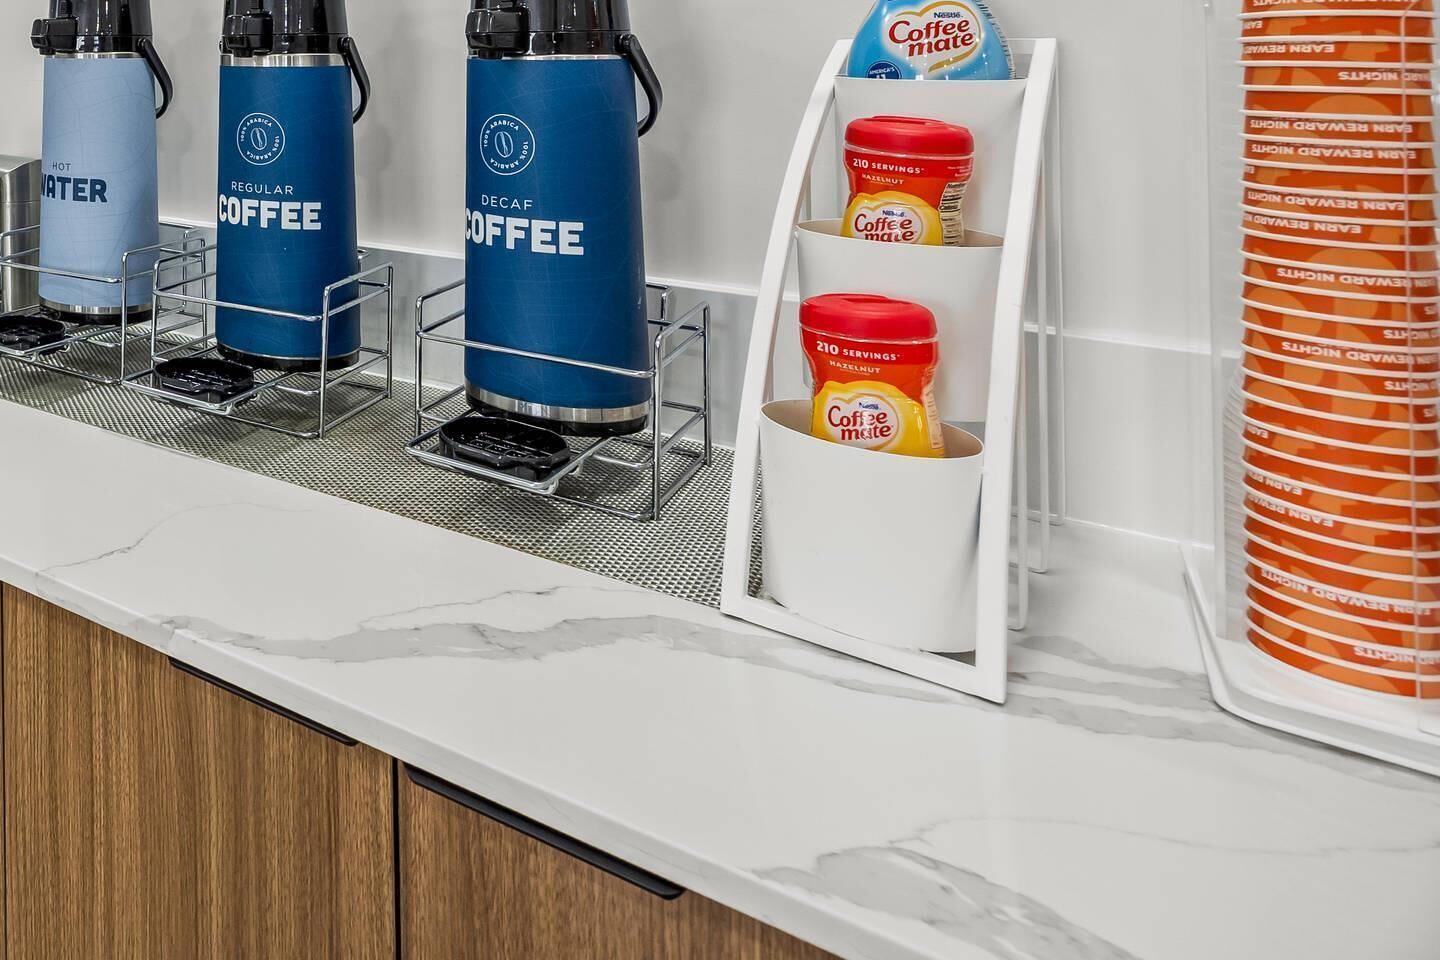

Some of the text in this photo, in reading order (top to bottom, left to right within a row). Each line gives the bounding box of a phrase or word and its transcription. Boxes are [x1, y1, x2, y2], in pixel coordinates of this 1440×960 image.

[888, 19, 970, 44] Coffee
[908, 32, 974, 57] mate
[1245, 43, 1335, 54] EARN REWAR
[1338, 71, 1398, 81] NIGHTS
[246, 117, 272, 128] ARABICA
[1250, 119, 1413, 134] EARN REWARD NIGHTS
[483, 119, 520, 147] 100% ARABICA
[246, 151, 272, 160] ARABICA
[490, 141, 529, 169] 100% ARABICA
[1251, 143, 1417, 160] EARN REWARD NIGHTS
[52, 161, 72, 172] HOT
[853, 158, 869, 169] 210
[862, 173, 905, 185] HAZELNUT
[231, 180, 294, 196] REGULAR
[481, 194, 533, 211] DECAF
[1247, 190, 1407, 212] EARN REWARD NIGHTS
[219, 193, 322, 231] COFFEE
[854, 213, 913, 233] Coffee
[1254, 214, 1310, 230] REWARD
[1313, 221, 1362, 234] EARN
[465, 207, 585, 256] COFFEE
[1276, 267, 1335, 283] NIGHTS
[1339, 273, 1413, 288] REWARD
[816, 340, 840, 355] 210
[1281, 341, 1341, 358] NIGHTS
[1346, 350, 1415, 365] REWARD
[829, 360, 881, 374] HAZELNUT
[840, 424, 892, 441] mate
[1264, 479, 1303, 496] EARN
[1288, 510, 1334, 528] EARN
[1260, 566, 1309, 594] NIGHTS
[1312, 587, 1390, 613] REWARD
[1353, 645, 1414, 664] NIGHTS
